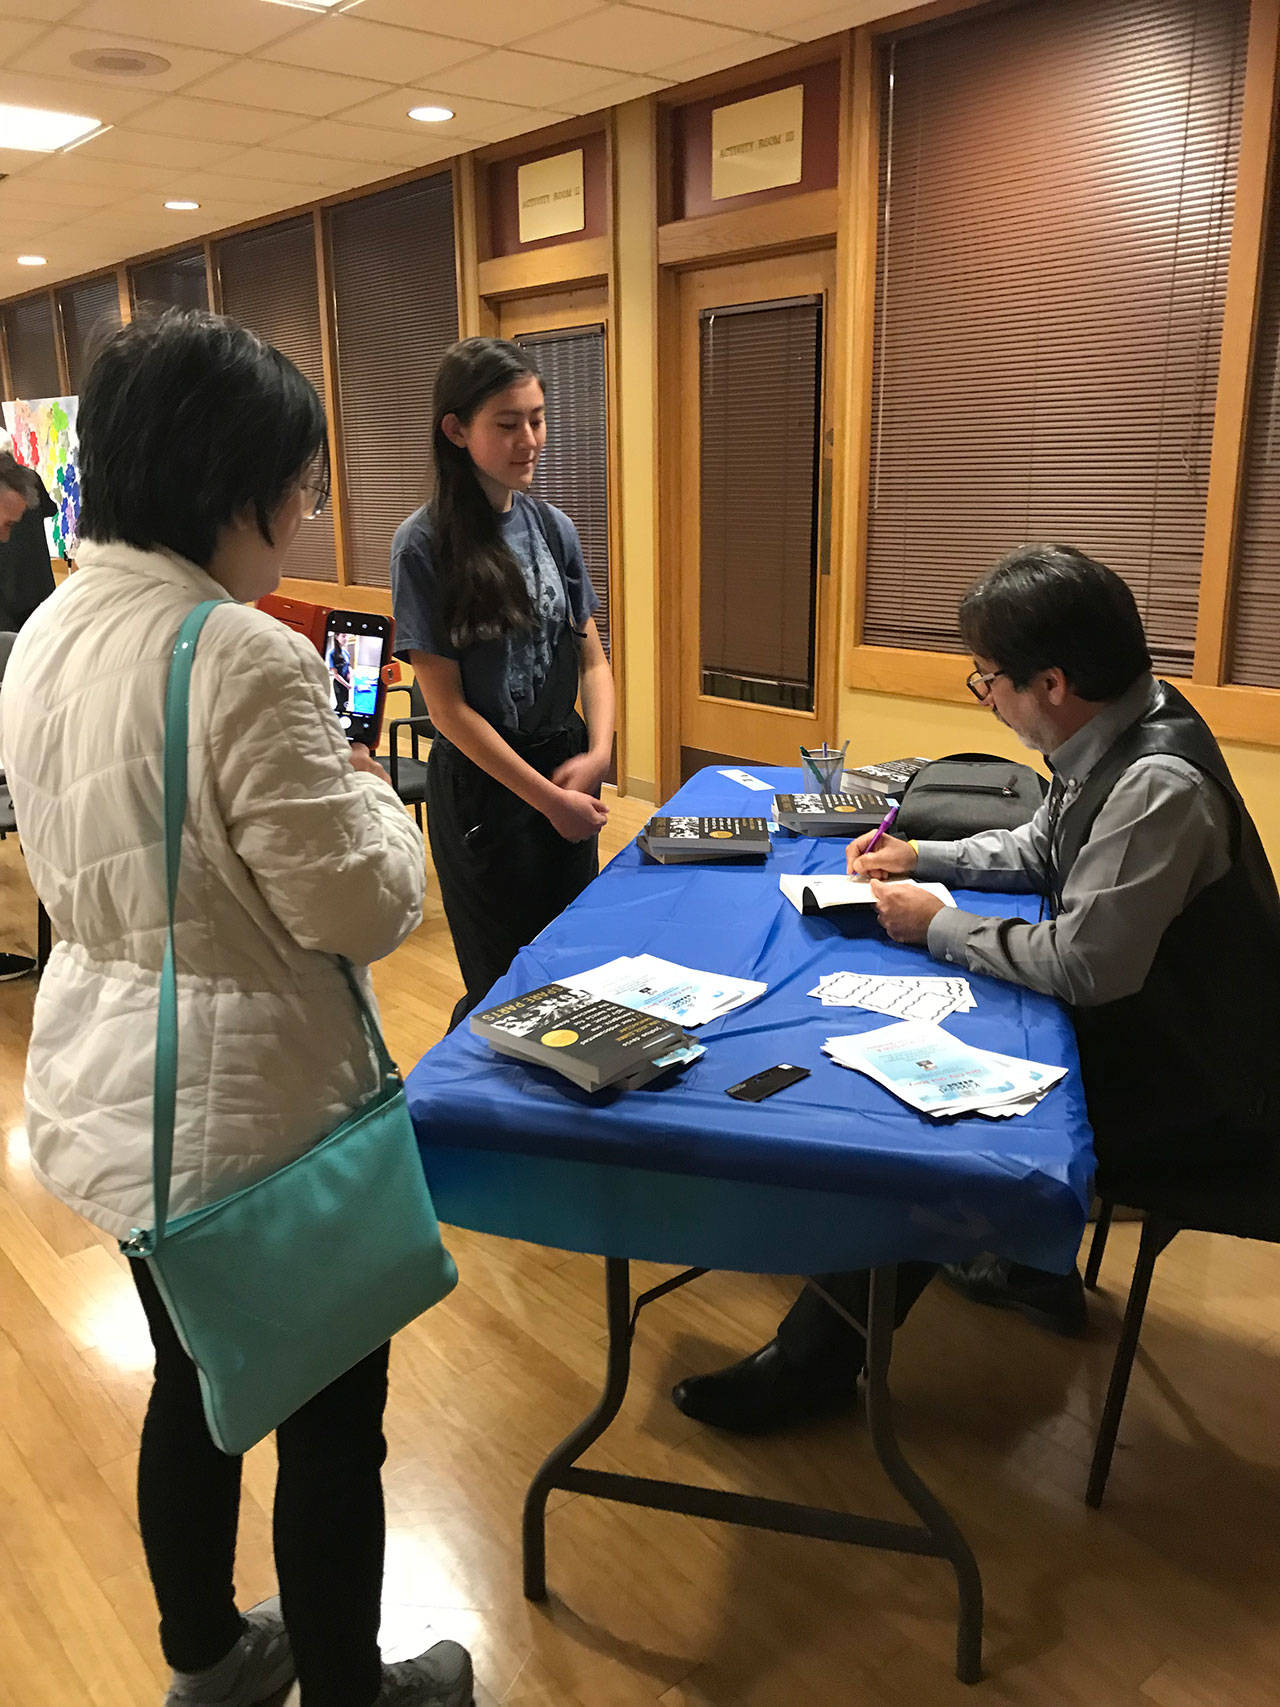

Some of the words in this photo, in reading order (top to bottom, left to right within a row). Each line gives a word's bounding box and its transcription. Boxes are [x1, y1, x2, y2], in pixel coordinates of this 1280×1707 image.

[720, 141, 754, 158] ACTIVITY
[758, 134, 782, 149] ROOM
[553, 189, 572, 201] ROOM
[480, 1000, 525, 1021] PARTS
